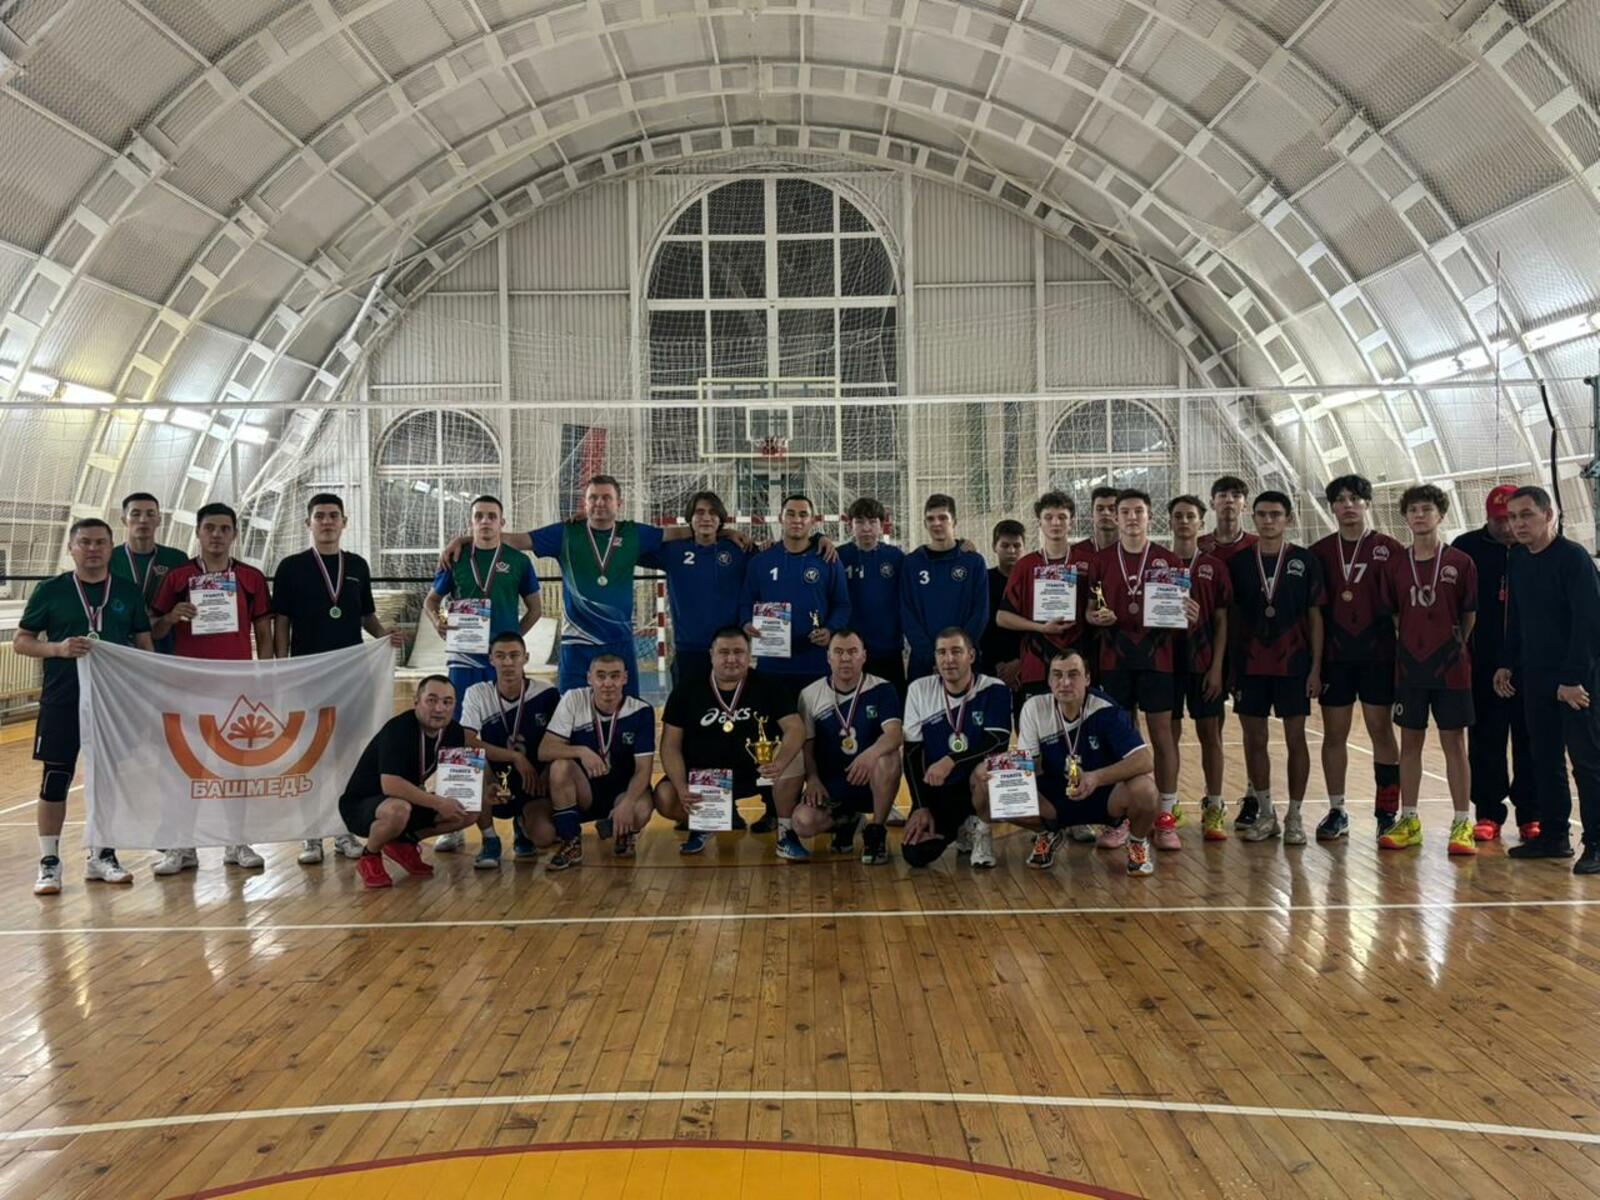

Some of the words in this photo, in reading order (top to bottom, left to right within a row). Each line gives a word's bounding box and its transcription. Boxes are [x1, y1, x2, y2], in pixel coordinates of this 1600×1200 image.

[683, 551, 695, 565] 2
[769, 567, 778, 581] 1
[919, 570, 930, 585] 3
[1410, 585, 1436, 607] 10
[191, 775, 313, 799] БАШМЕДЬ
